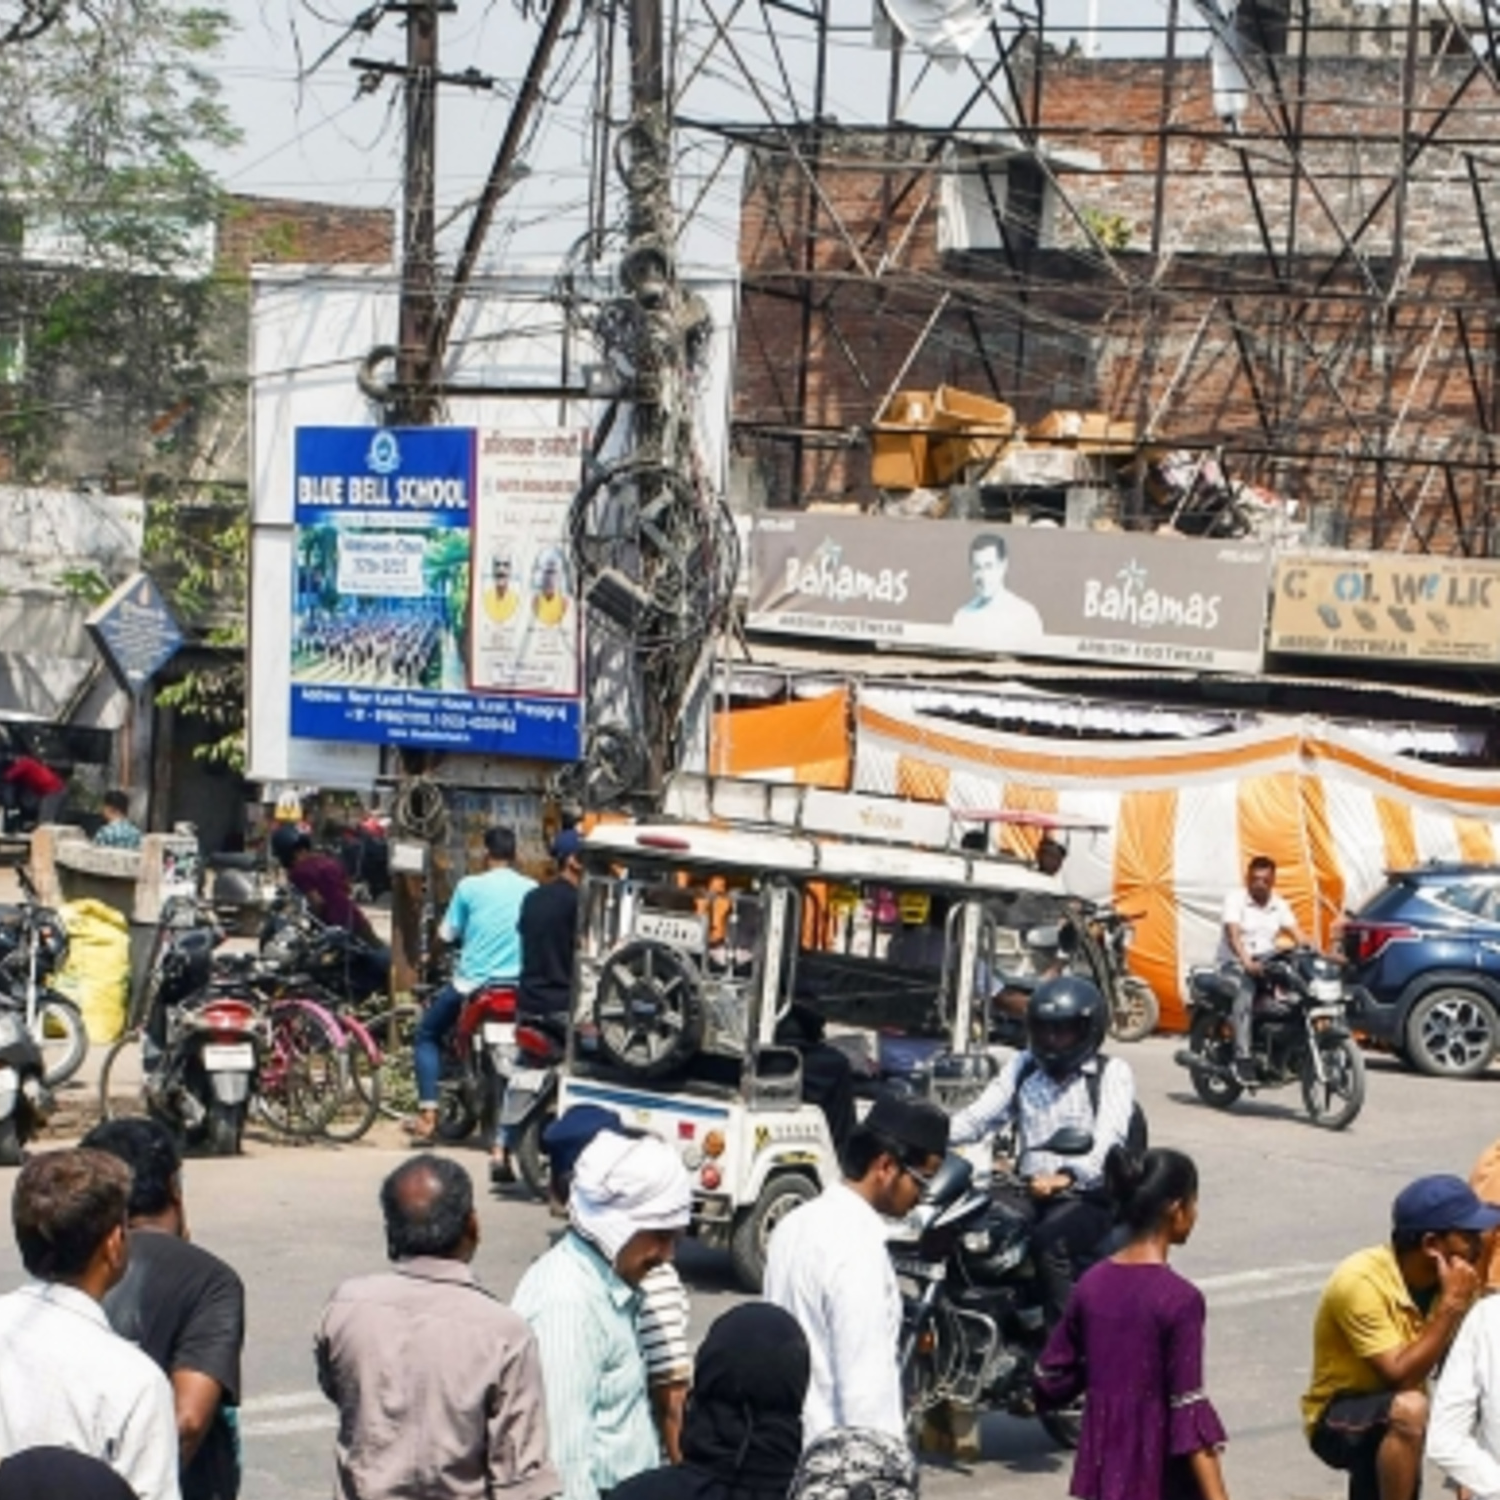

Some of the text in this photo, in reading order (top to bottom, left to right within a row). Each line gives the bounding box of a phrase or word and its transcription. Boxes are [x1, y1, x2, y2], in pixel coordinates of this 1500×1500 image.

[298, 475, 344, 505] BLUE
[349, 476, 391, 505] BELL
[395, 478, 468, 509] SCHOOL
[787, 554, 909, 603] Bahamas
[1084, 574, 1222, 630] Bahamas
